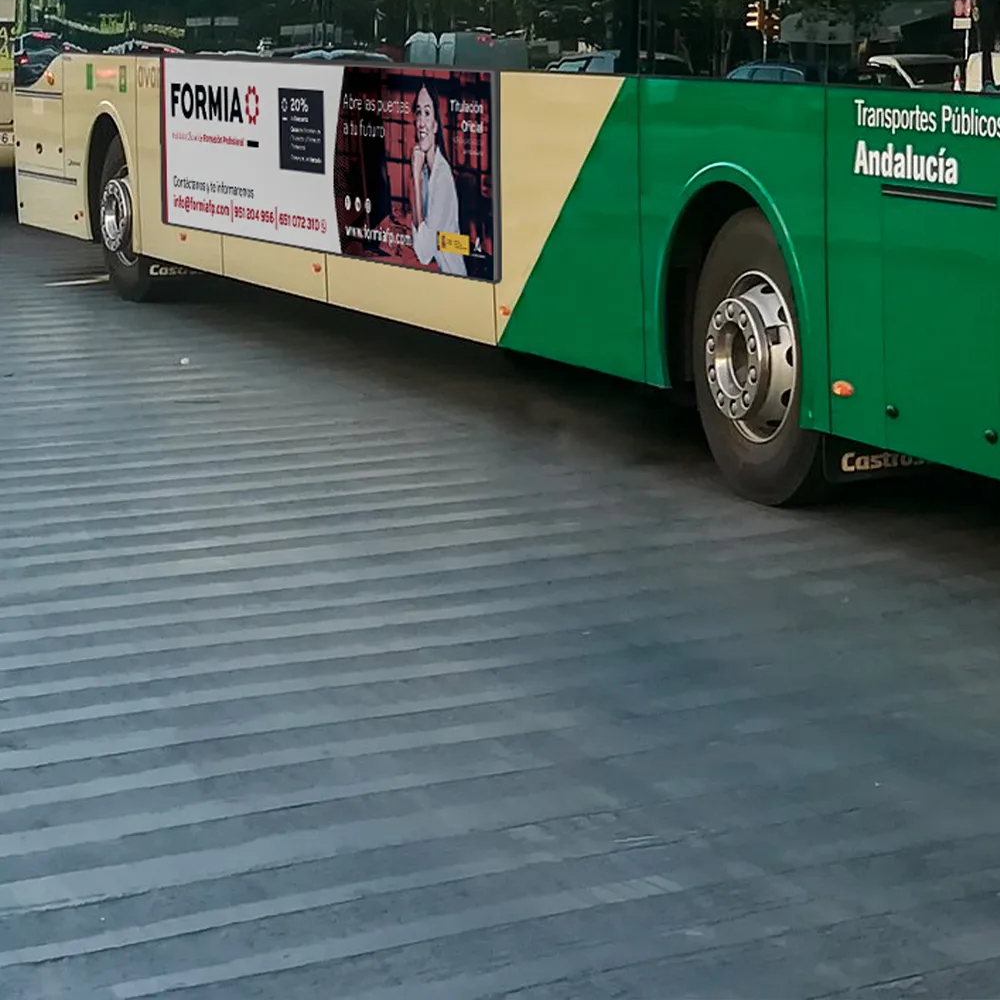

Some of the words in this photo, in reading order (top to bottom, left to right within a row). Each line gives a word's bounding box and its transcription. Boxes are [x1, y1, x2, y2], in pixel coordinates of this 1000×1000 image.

[171, 82, 244, 124] FORMIA
[290, 97, 309, 113] 20%
[854, 99, 937, 134] Transportes
[854, 140, 958, 185] Andalucía
